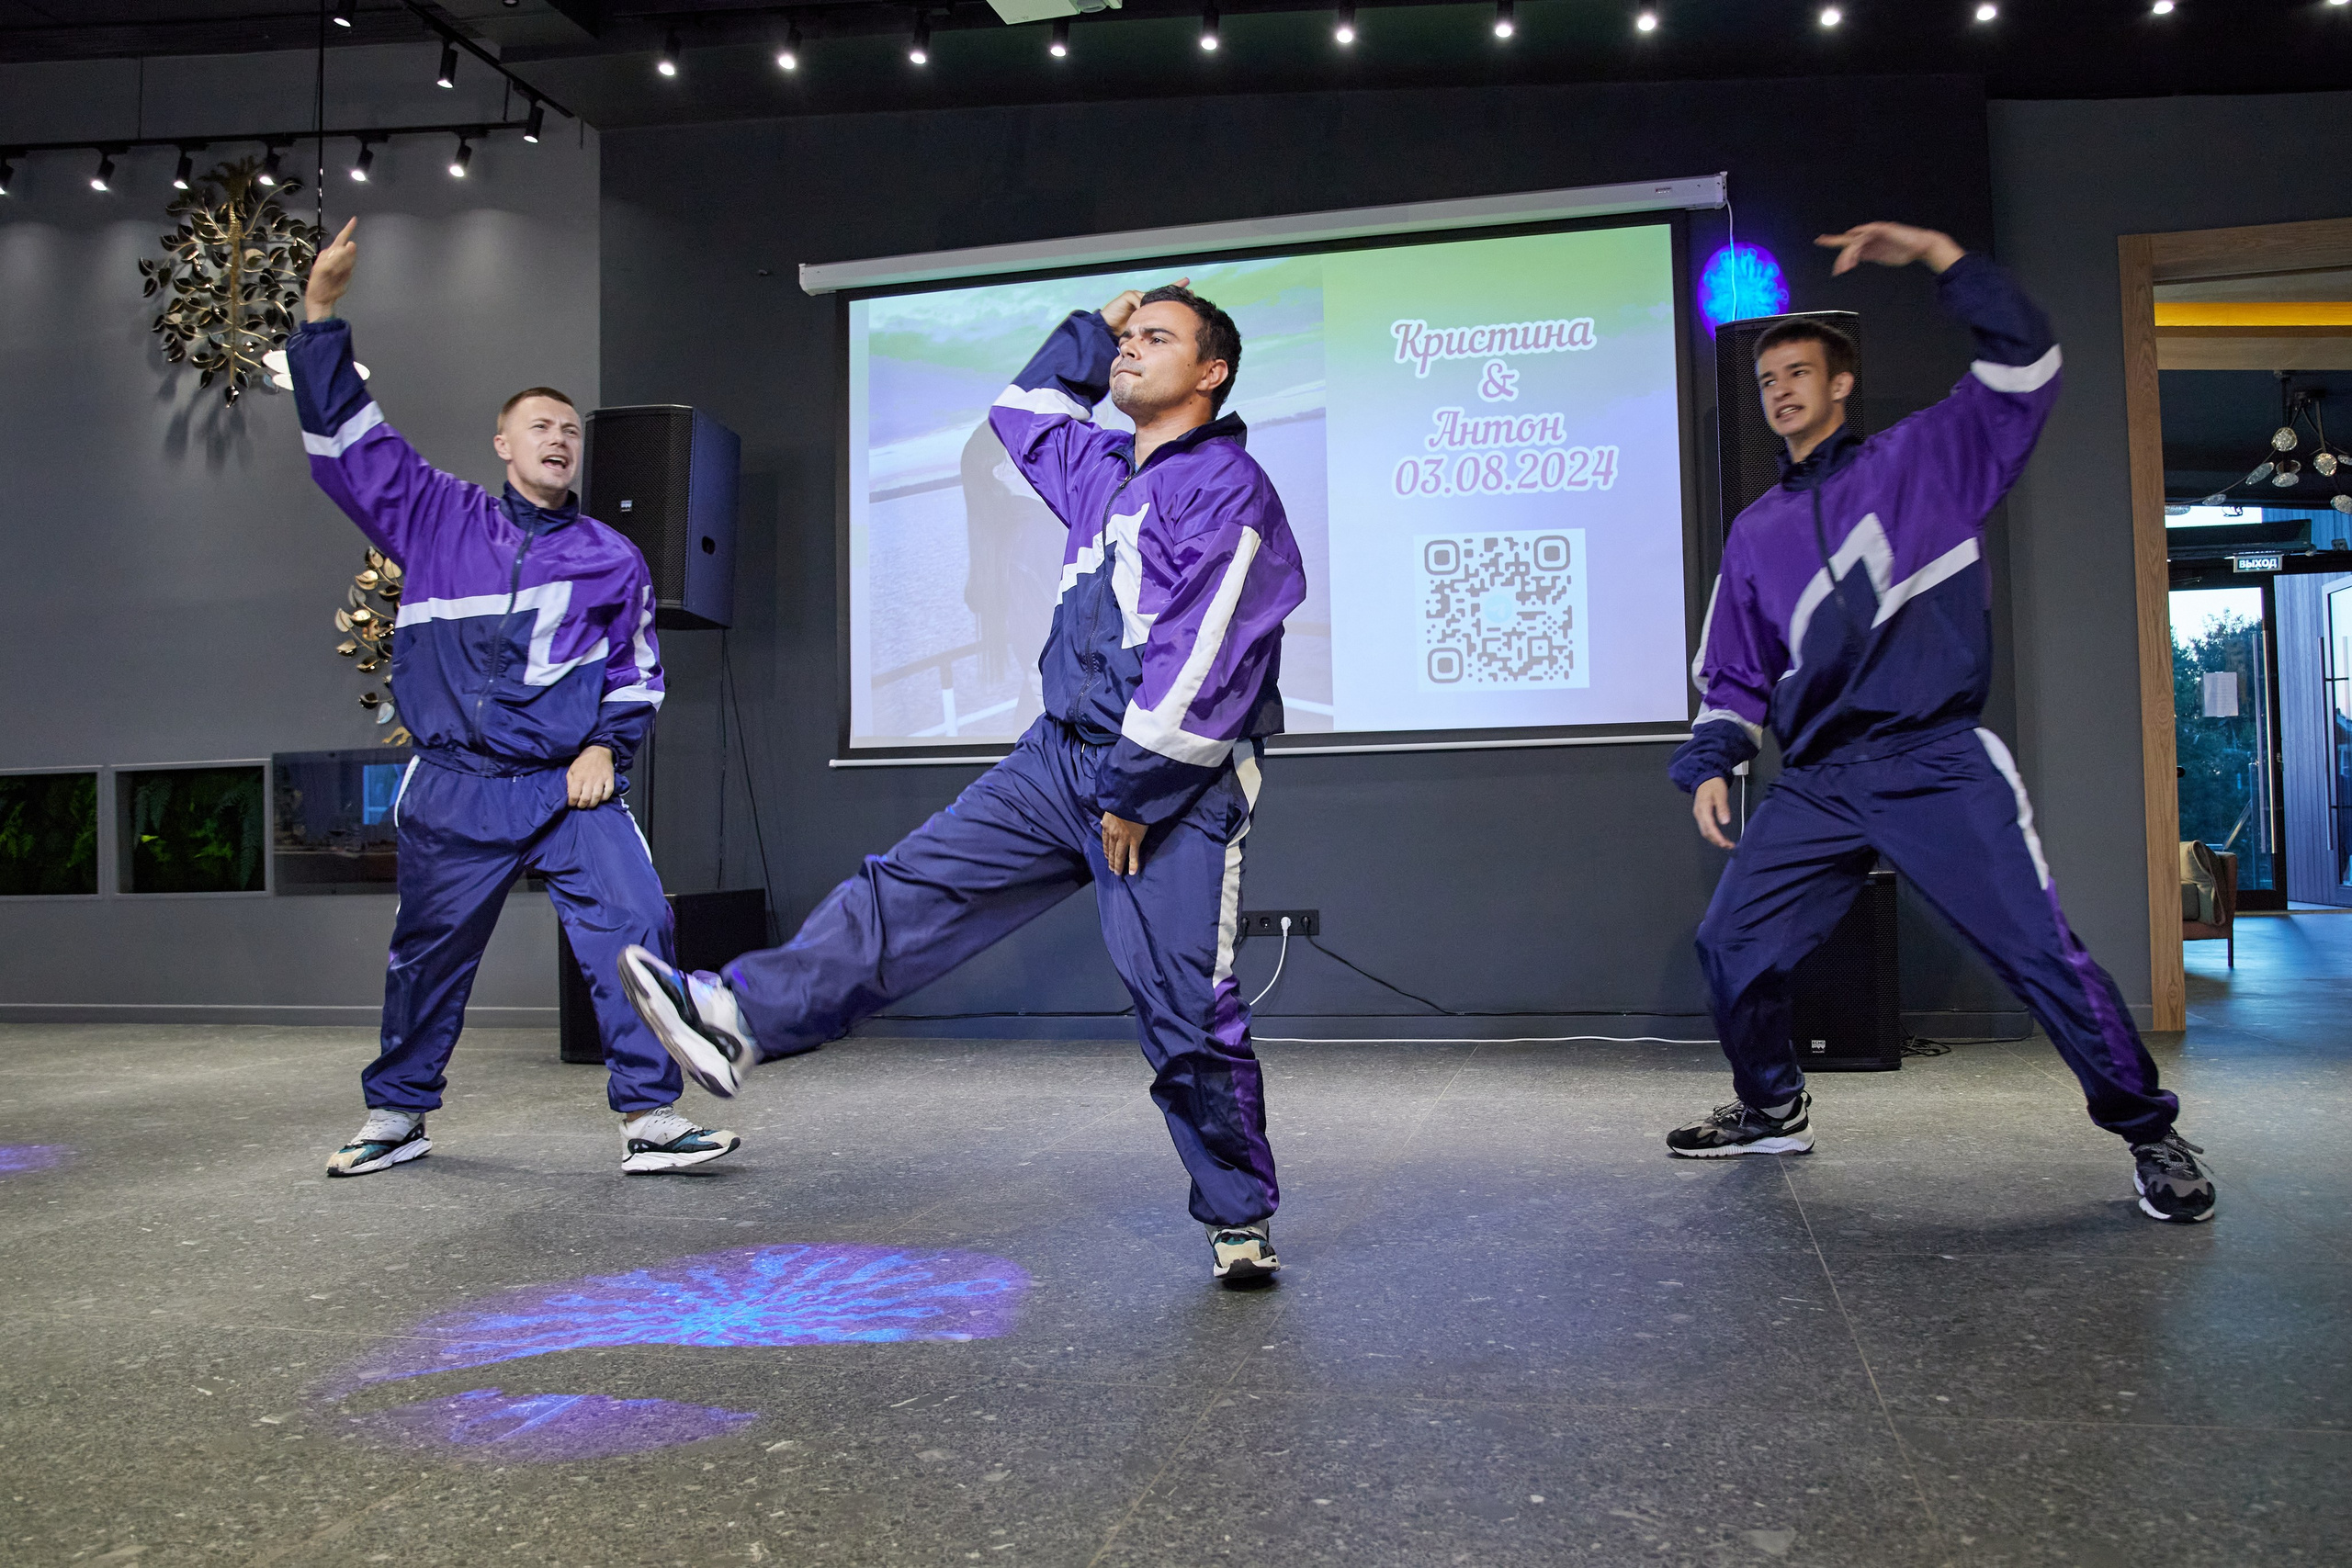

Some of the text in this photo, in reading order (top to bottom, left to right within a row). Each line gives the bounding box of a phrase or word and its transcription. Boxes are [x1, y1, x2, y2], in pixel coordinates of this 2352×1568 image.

[1394, 319, 1594, 376] Кристина
[1481, 362, 1516, 400] &
[1428, 410, 1564, 448] Антон
[1395, 448, 1616, 496] 03.08.2024
[2238, 558, 2278, 570] ВЫХОД
